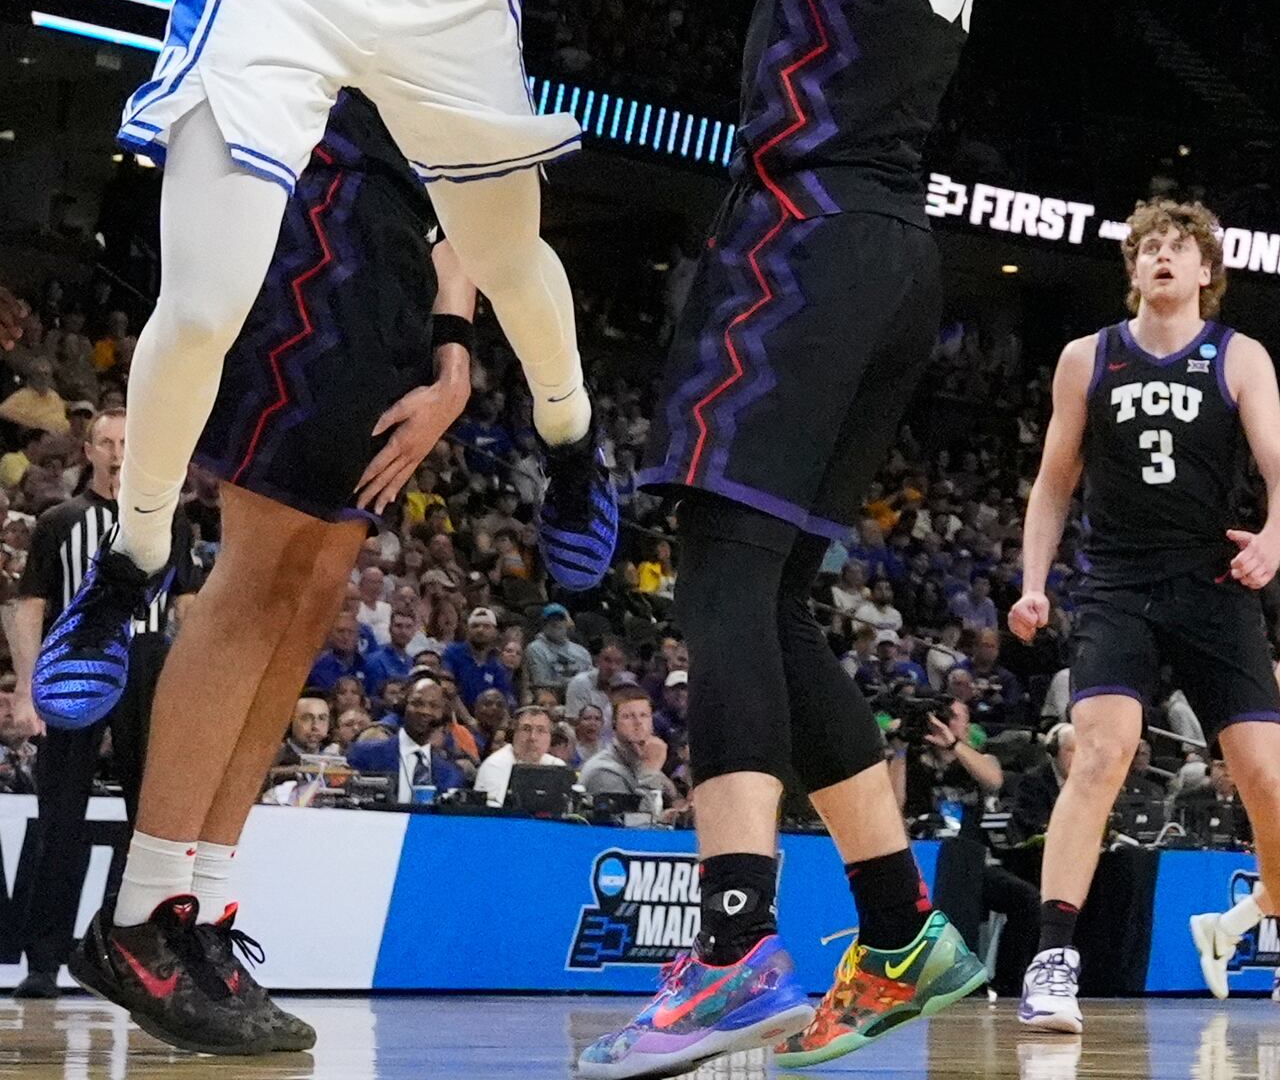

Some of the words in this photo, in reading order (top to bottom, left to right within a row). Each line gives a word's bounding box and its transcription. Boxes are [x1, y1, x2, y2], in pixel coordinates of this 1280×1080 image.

[969, 183, 1095, 245] FIRST
[1110, 380, 1203, 424] TCU
[1138, 428, 1177, 486] 3
[623, 860, 702, 904] MAR
